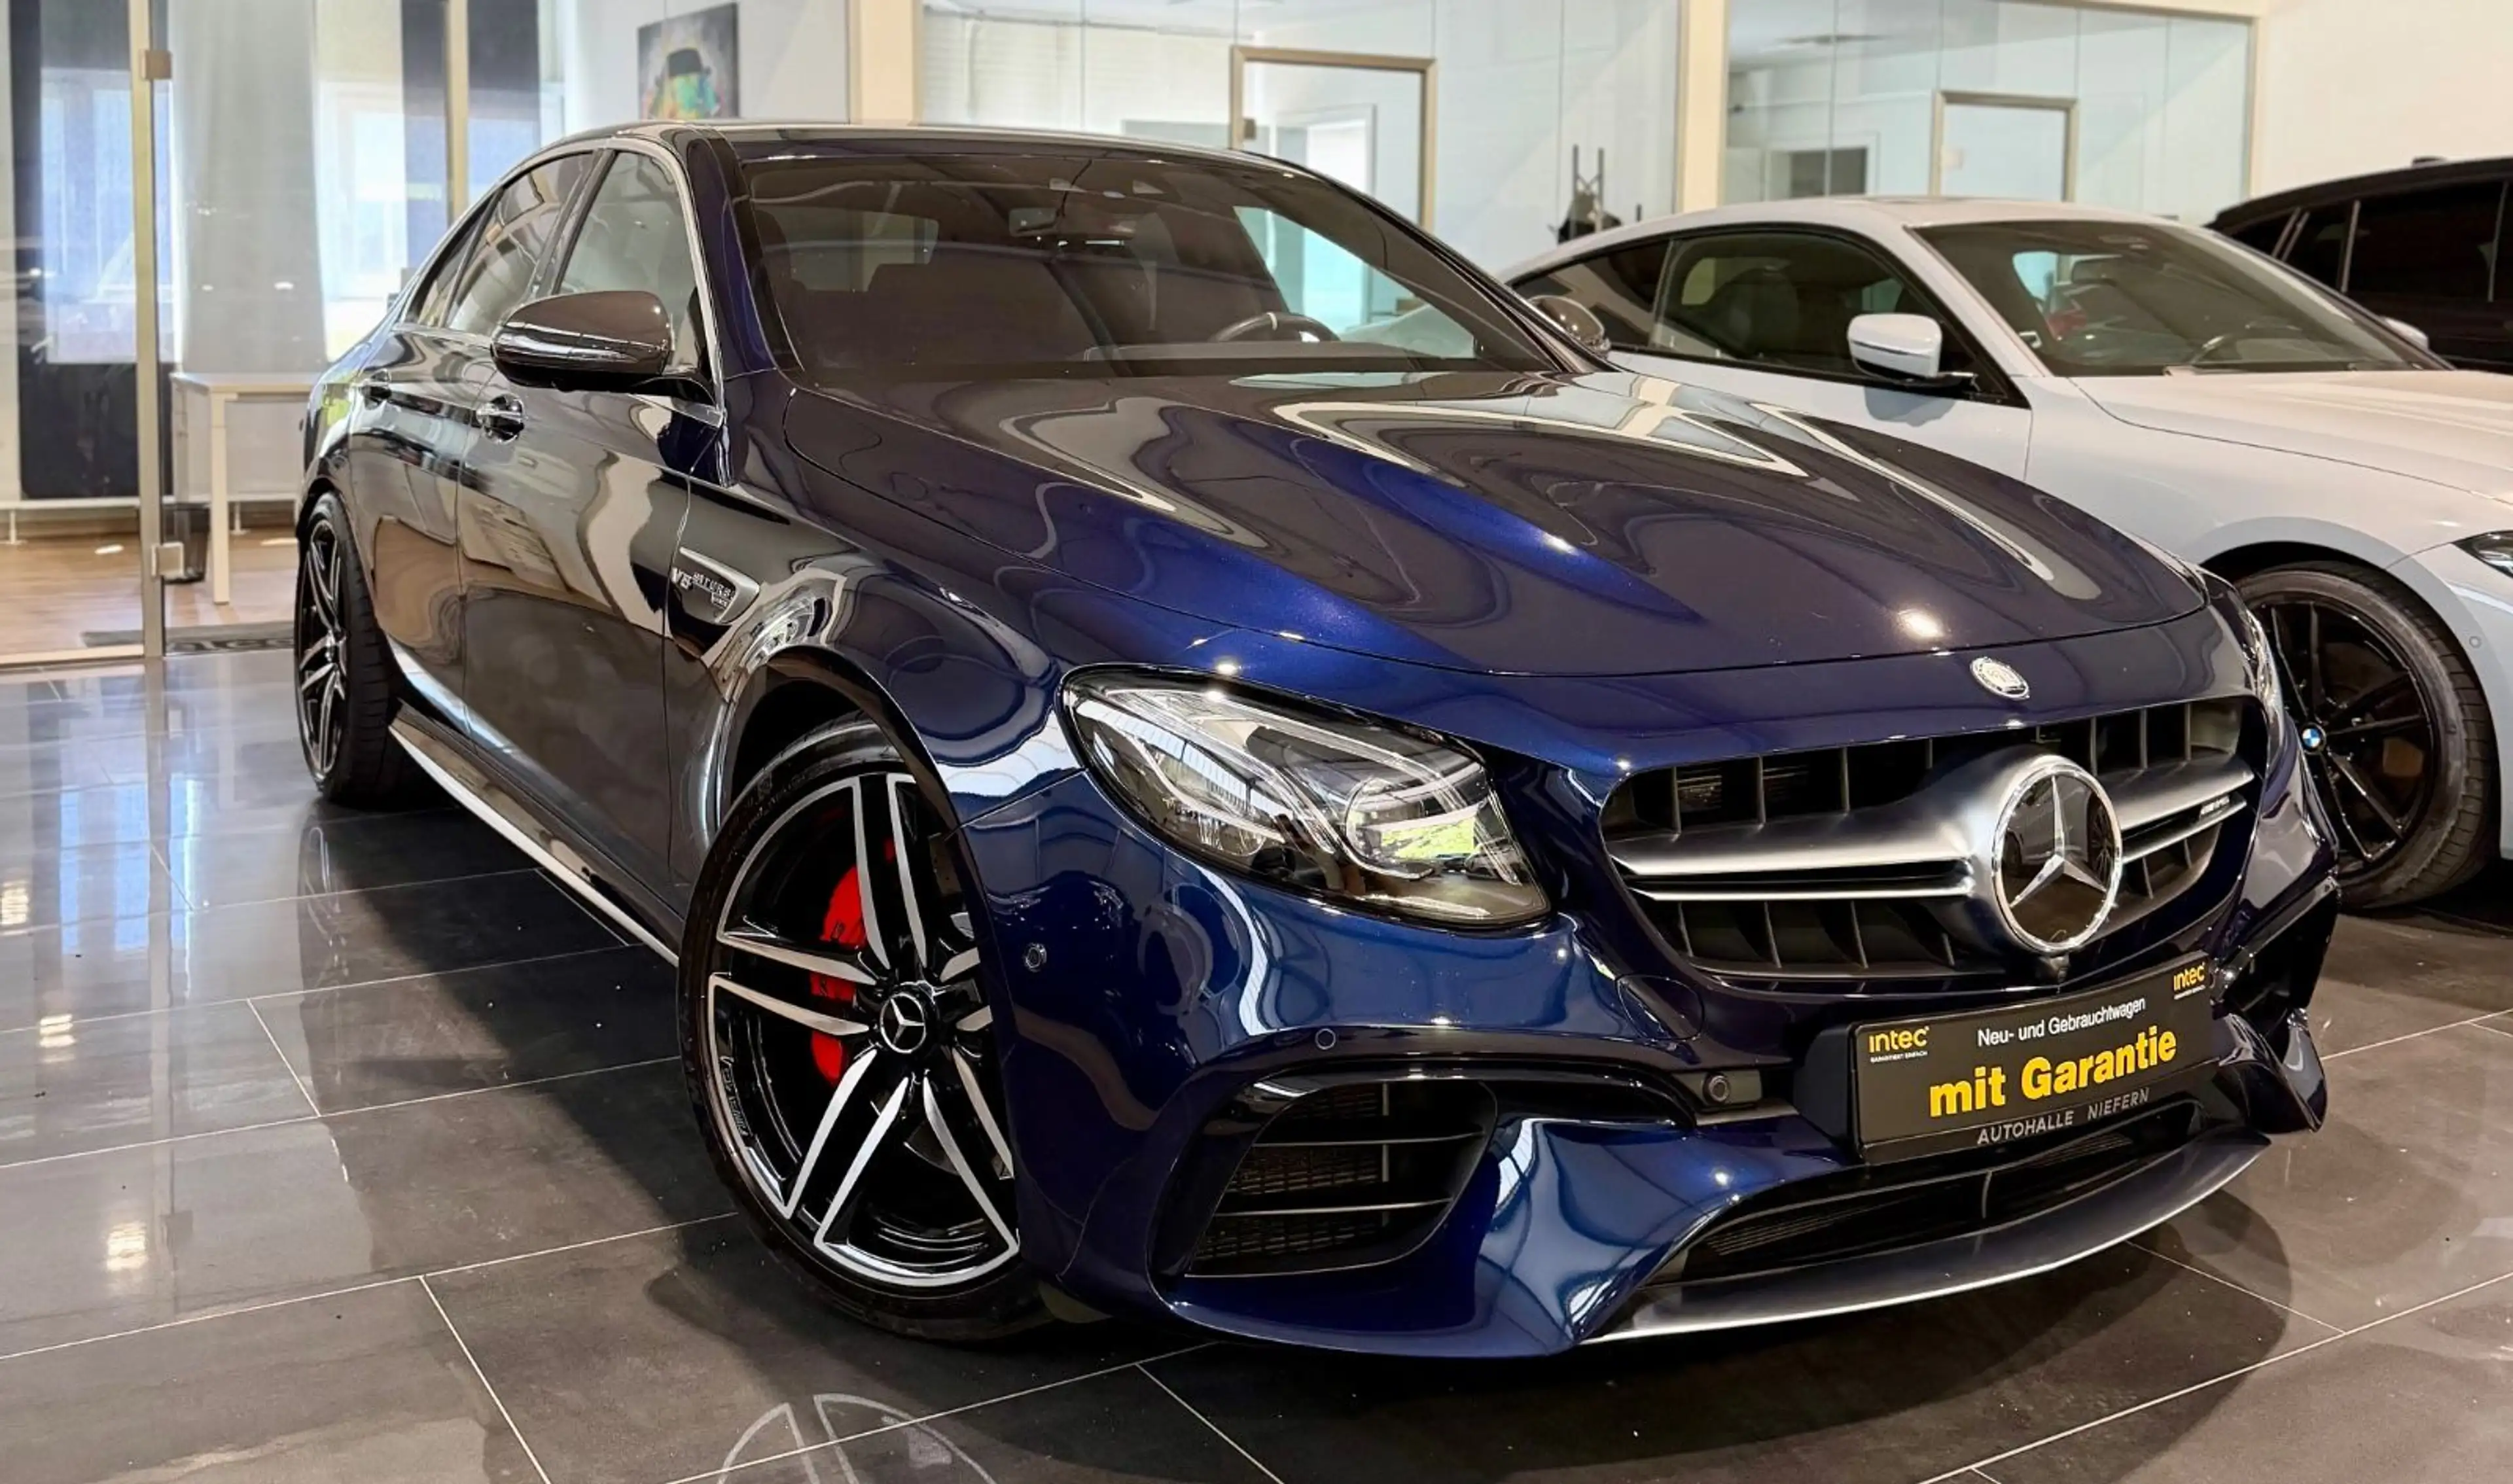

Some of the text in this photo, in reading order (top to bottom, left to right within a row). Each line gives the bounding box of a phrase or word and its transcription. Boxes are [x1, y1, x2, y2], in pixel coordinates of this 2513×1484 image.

[2173, 964, 2205, 991] intec
[1869, 1027, 1929, 1053] intec
[1978, 997, 2145, 1047] Neu- und Gebrauchtwagen
[1930, 1025, 2177, 1117] mit Garantie
[1977, 1087, 2149, 1144] AUTOHALLE NIEFERN
